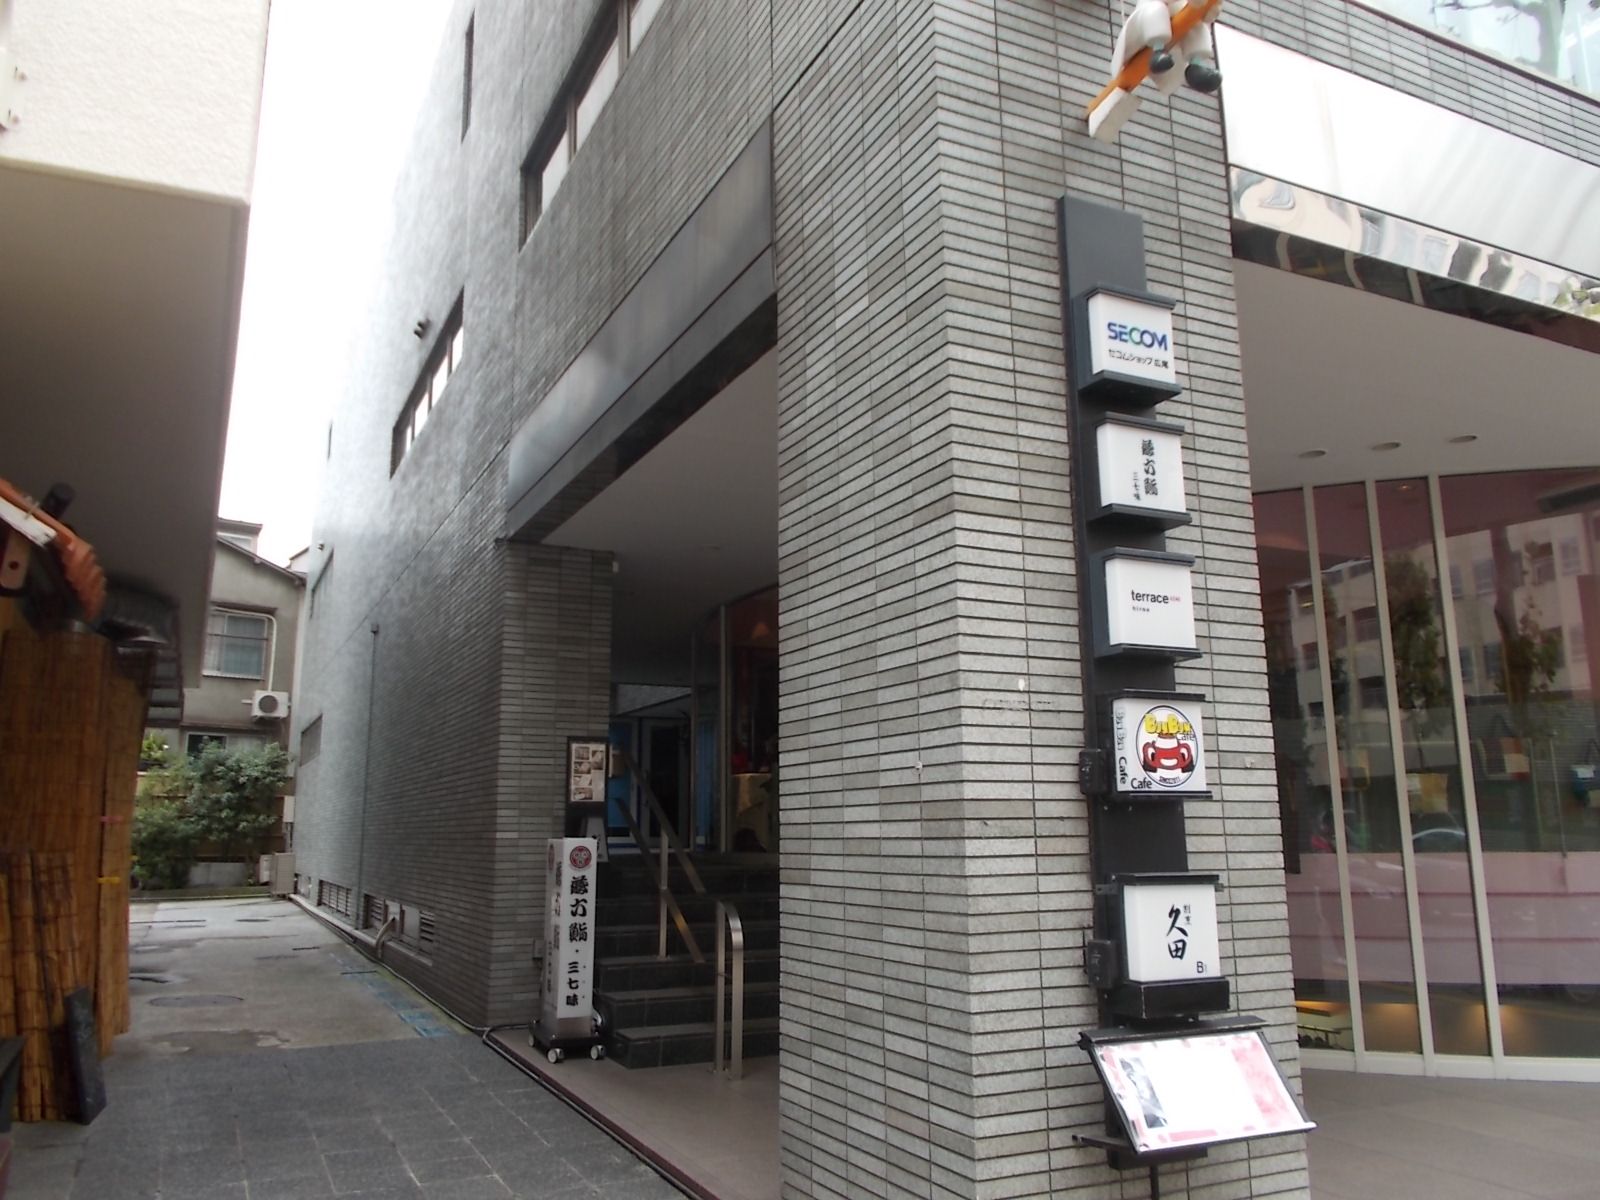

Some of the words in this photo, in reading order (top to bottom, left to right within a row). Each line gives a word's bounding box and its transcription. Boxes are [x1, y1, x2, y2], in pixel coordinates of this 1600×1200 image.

[1107, 322, 1168, 351] SECOM
[1131, 589, 1169, 604] terrace
[1118, 756, 1129, 785] Cafe
[1130, 777, 1153, 790] Cafe
[1166, 904, 1189, 961] 久田
